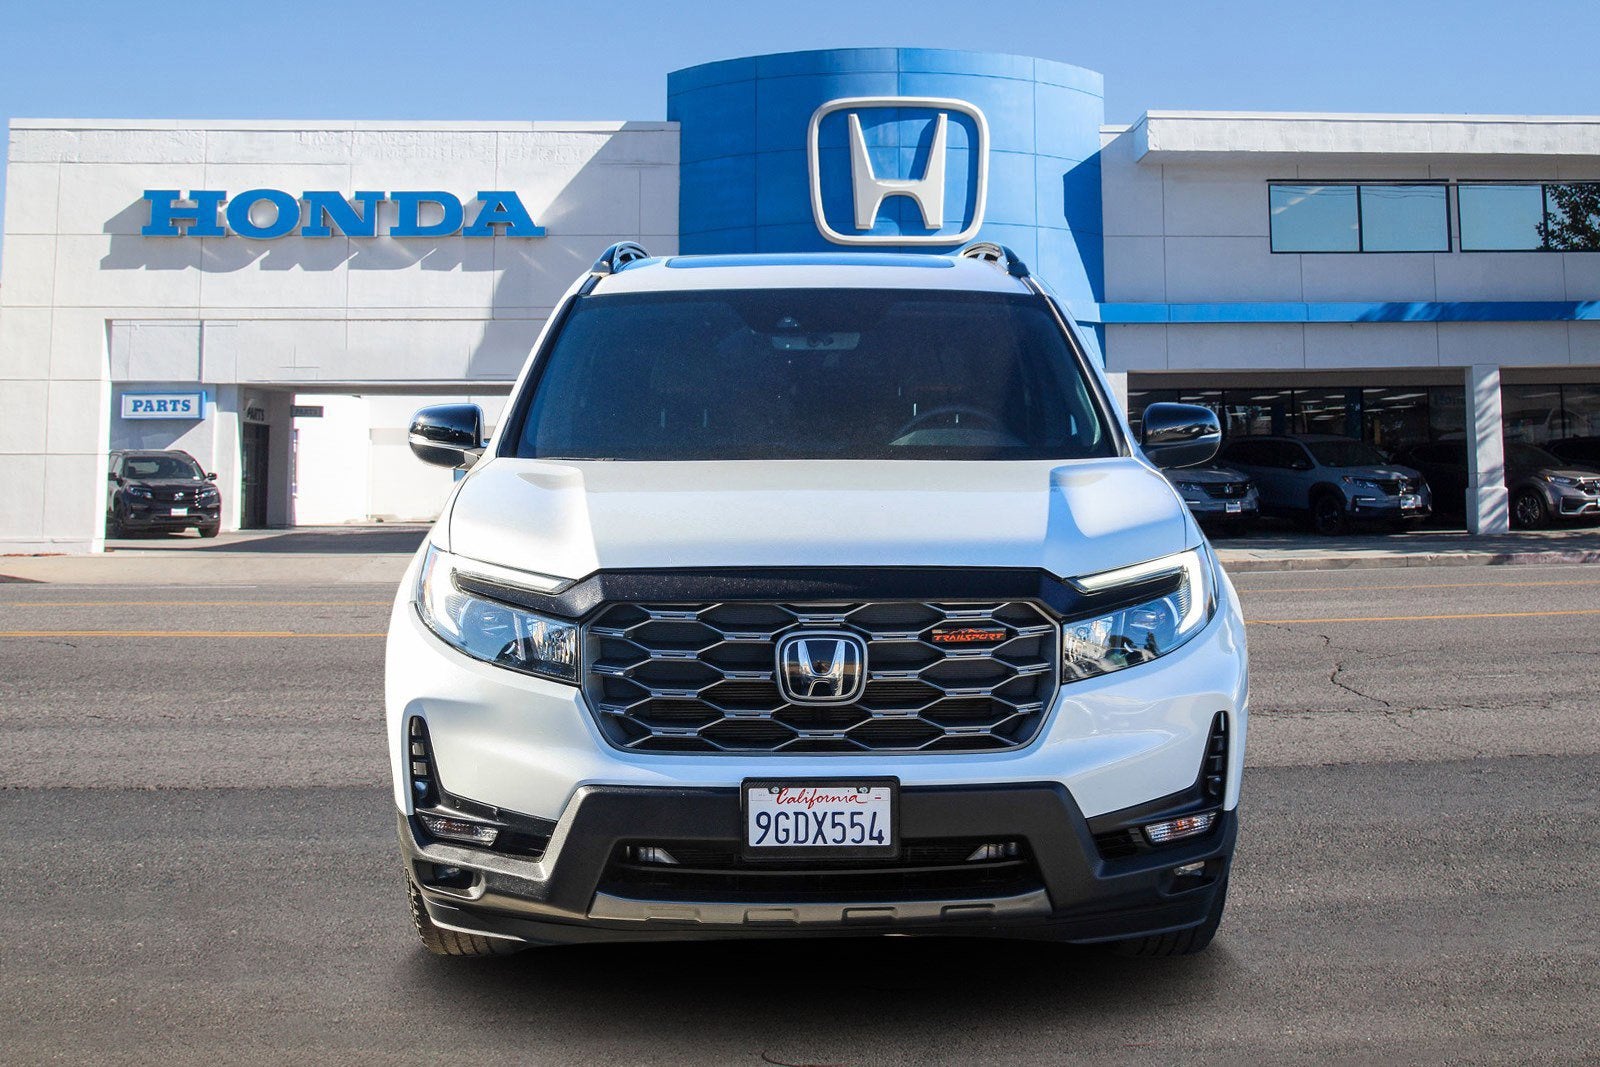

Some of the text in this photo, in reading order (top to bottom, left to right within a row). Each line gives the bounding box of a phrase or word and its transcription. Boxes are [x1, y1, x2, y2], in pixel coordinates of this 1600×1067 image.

[141, 188, 547, 239] HONDA
[132, 399, 191, 412] PARTS
[933, 632, 1004, 642] TRAILSPORT
[776, 787, 867, 810] California
[755, 811, 885, 844] 9GDX554
